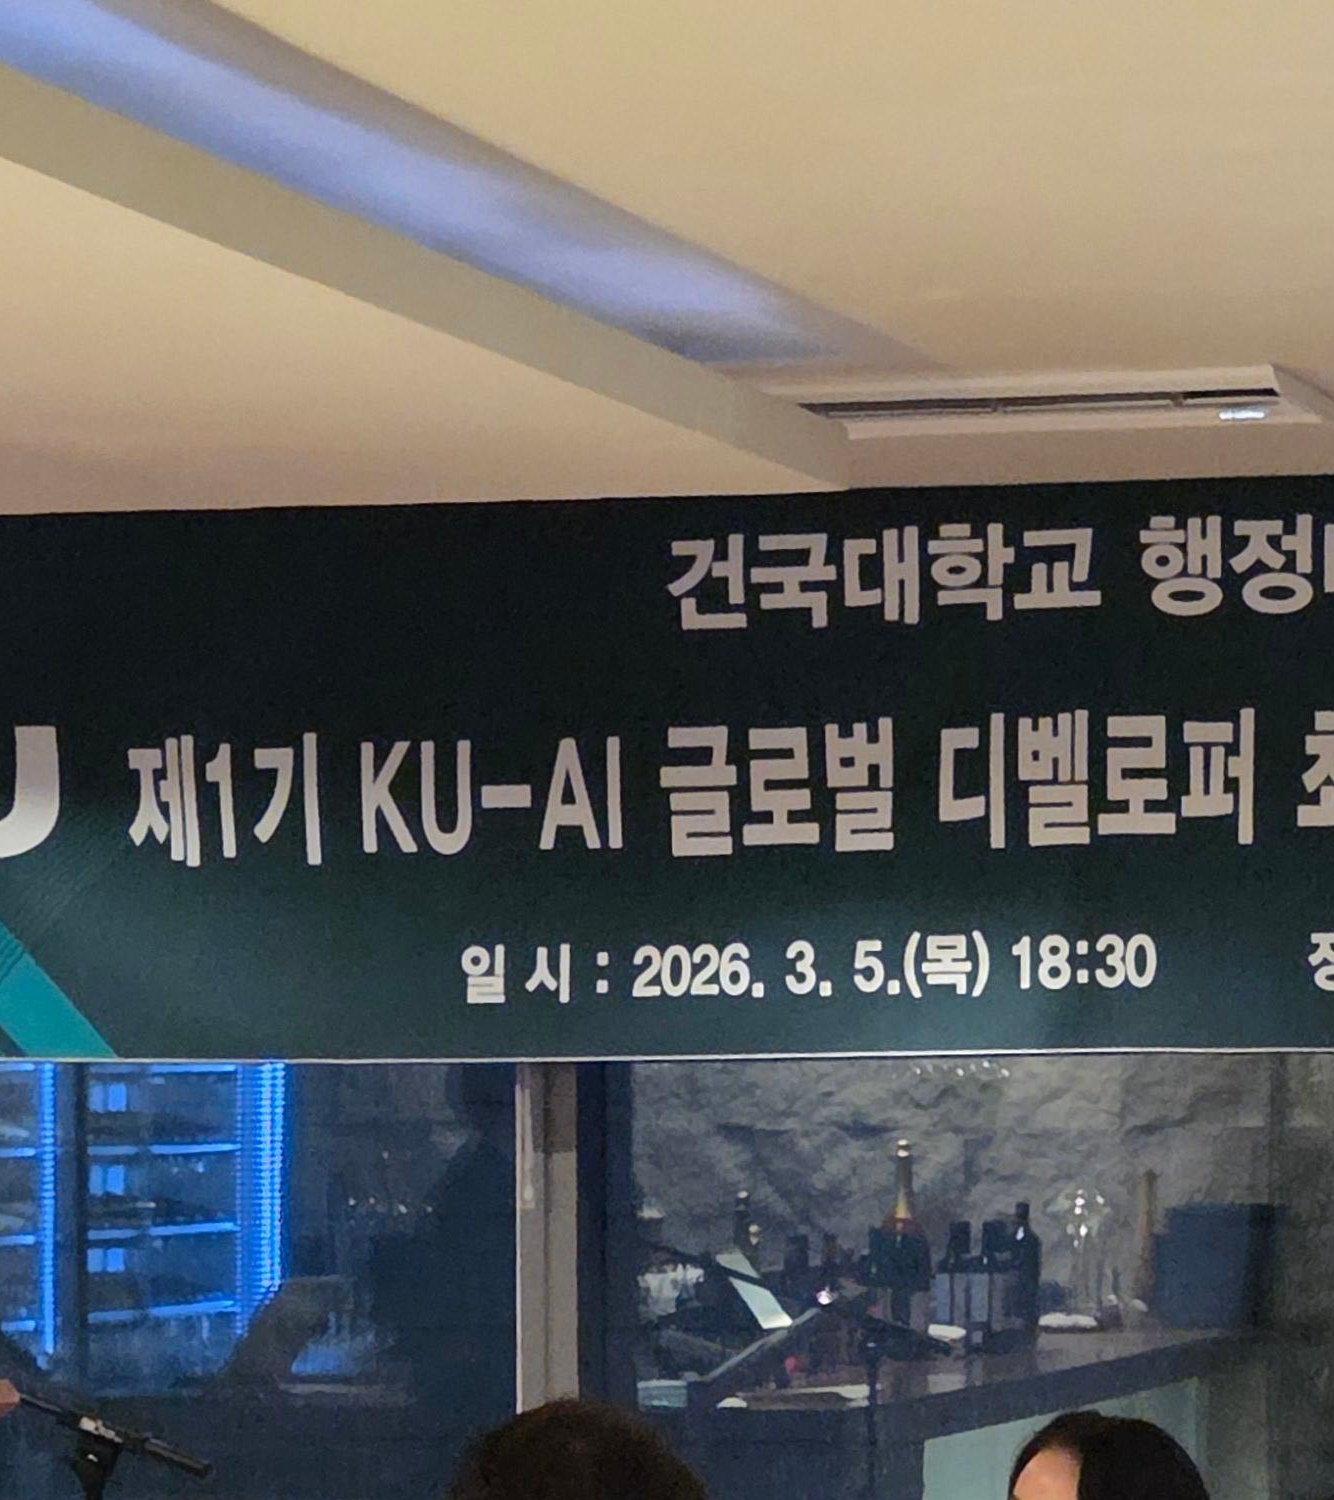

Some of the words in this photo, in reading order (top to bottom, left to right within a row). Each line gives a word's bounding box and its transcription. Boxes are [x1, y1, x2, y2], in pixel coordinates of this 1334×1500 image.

[668, 522, 1101, 630] 건국대학교
[127, 731, 323, 868] 제1기
[360, 736, 624, 856] KU-AI
[659, 716, 896, 858] 글로벌
[937, 707, 1256, 850] 디벨로퍼
[630, 940, 766, 1000] 2026.
[783, 938, 834, 999] 3.
[1010, 932, 1159, 992] 18:30
